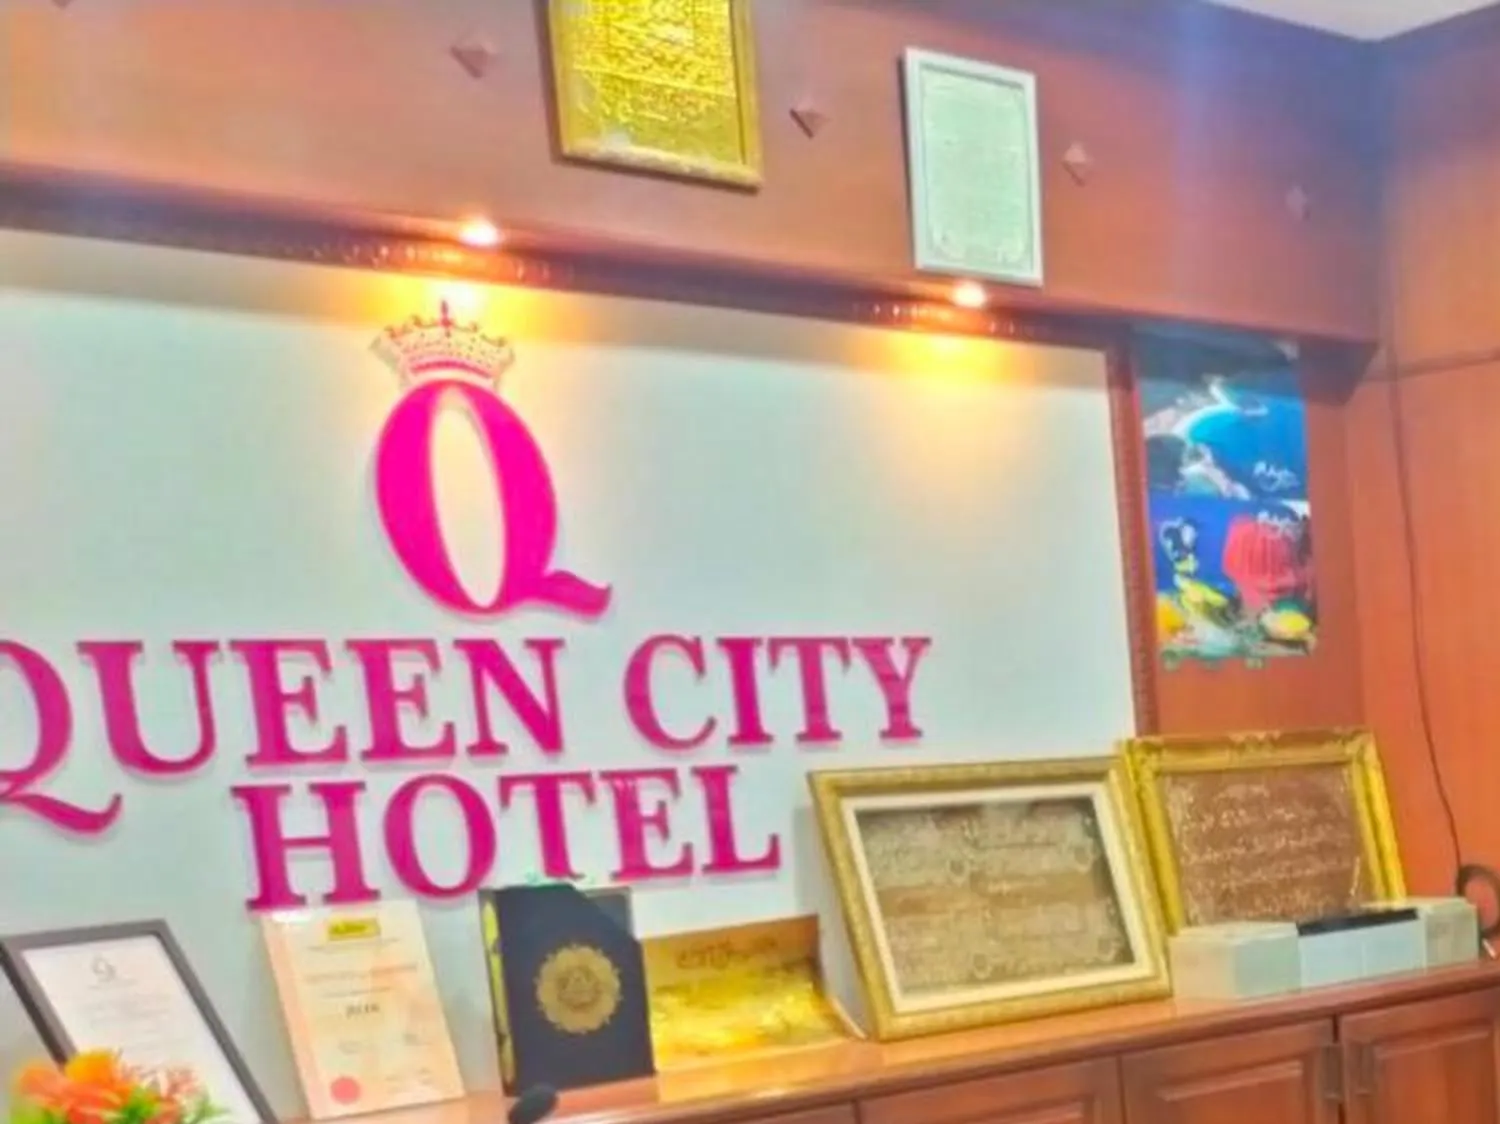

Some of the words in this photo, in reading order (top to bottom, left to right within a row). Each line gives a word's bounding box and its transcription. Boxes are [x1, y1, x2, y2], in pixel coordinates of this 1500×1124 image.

[377, 378, 612, 617] Q
[623, 634, 931, 751] CITY
[231, 765, 781, 911] HOTEL
